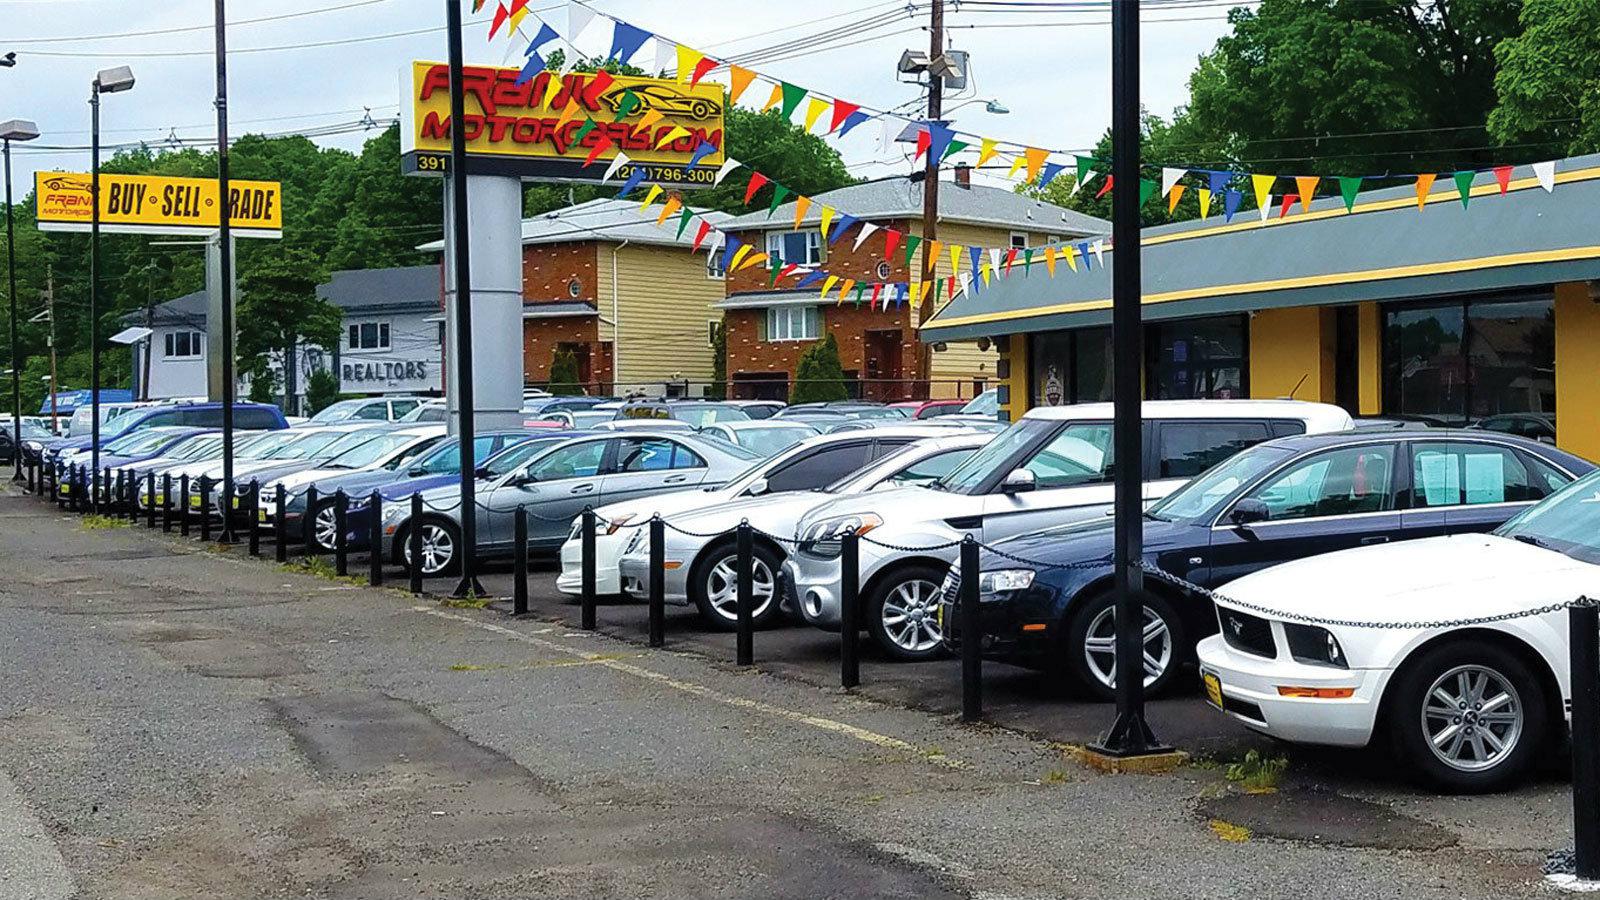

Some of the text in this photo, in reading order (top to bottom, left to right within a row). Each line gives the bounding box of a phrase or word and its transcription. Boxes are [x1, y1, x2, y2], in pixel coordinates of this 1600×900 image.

[418, 156, 446, 170] 391
[616, 166, 718, 182] (2)796-300
[45, 194, 93, 208] FRAN
[108, 183, 274, 220] BUY SELL RADE
[343, 361, 427, 382] REALTORS
